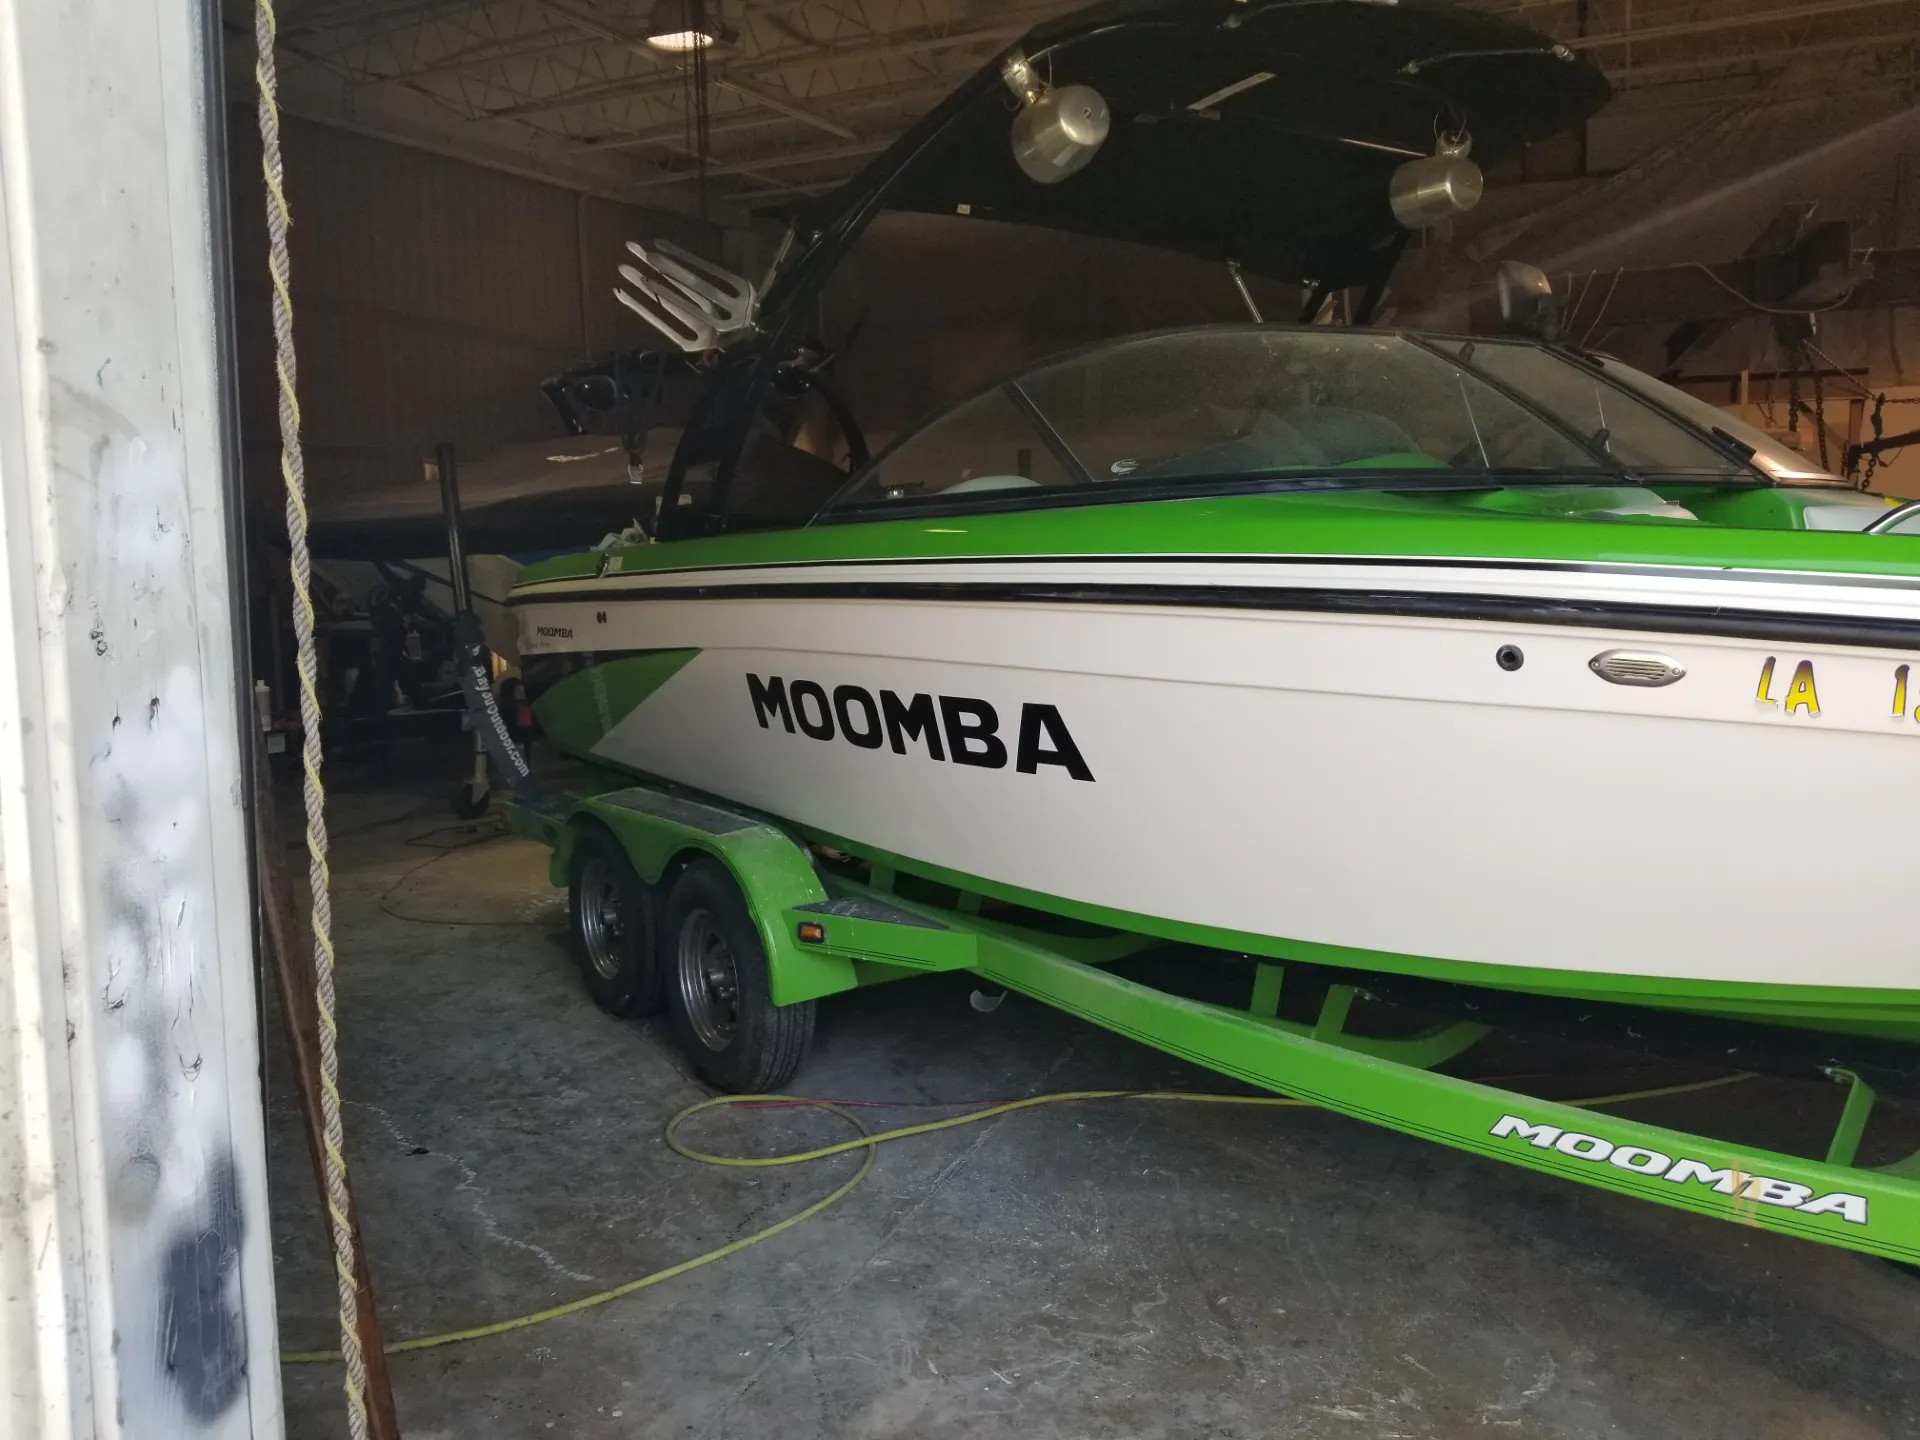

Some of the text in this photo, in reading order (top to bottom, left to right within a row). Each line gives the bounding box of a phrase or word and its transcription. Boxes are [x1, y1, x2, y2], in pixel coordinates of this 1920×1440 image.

[536, 626, 573, 639] MOOMBA
[745, 672, 1097, 783] MOOMBA
[1755, 656, 1920, 723] LA 1
[1488, 1113, 1869, 1226] MOOMBA
